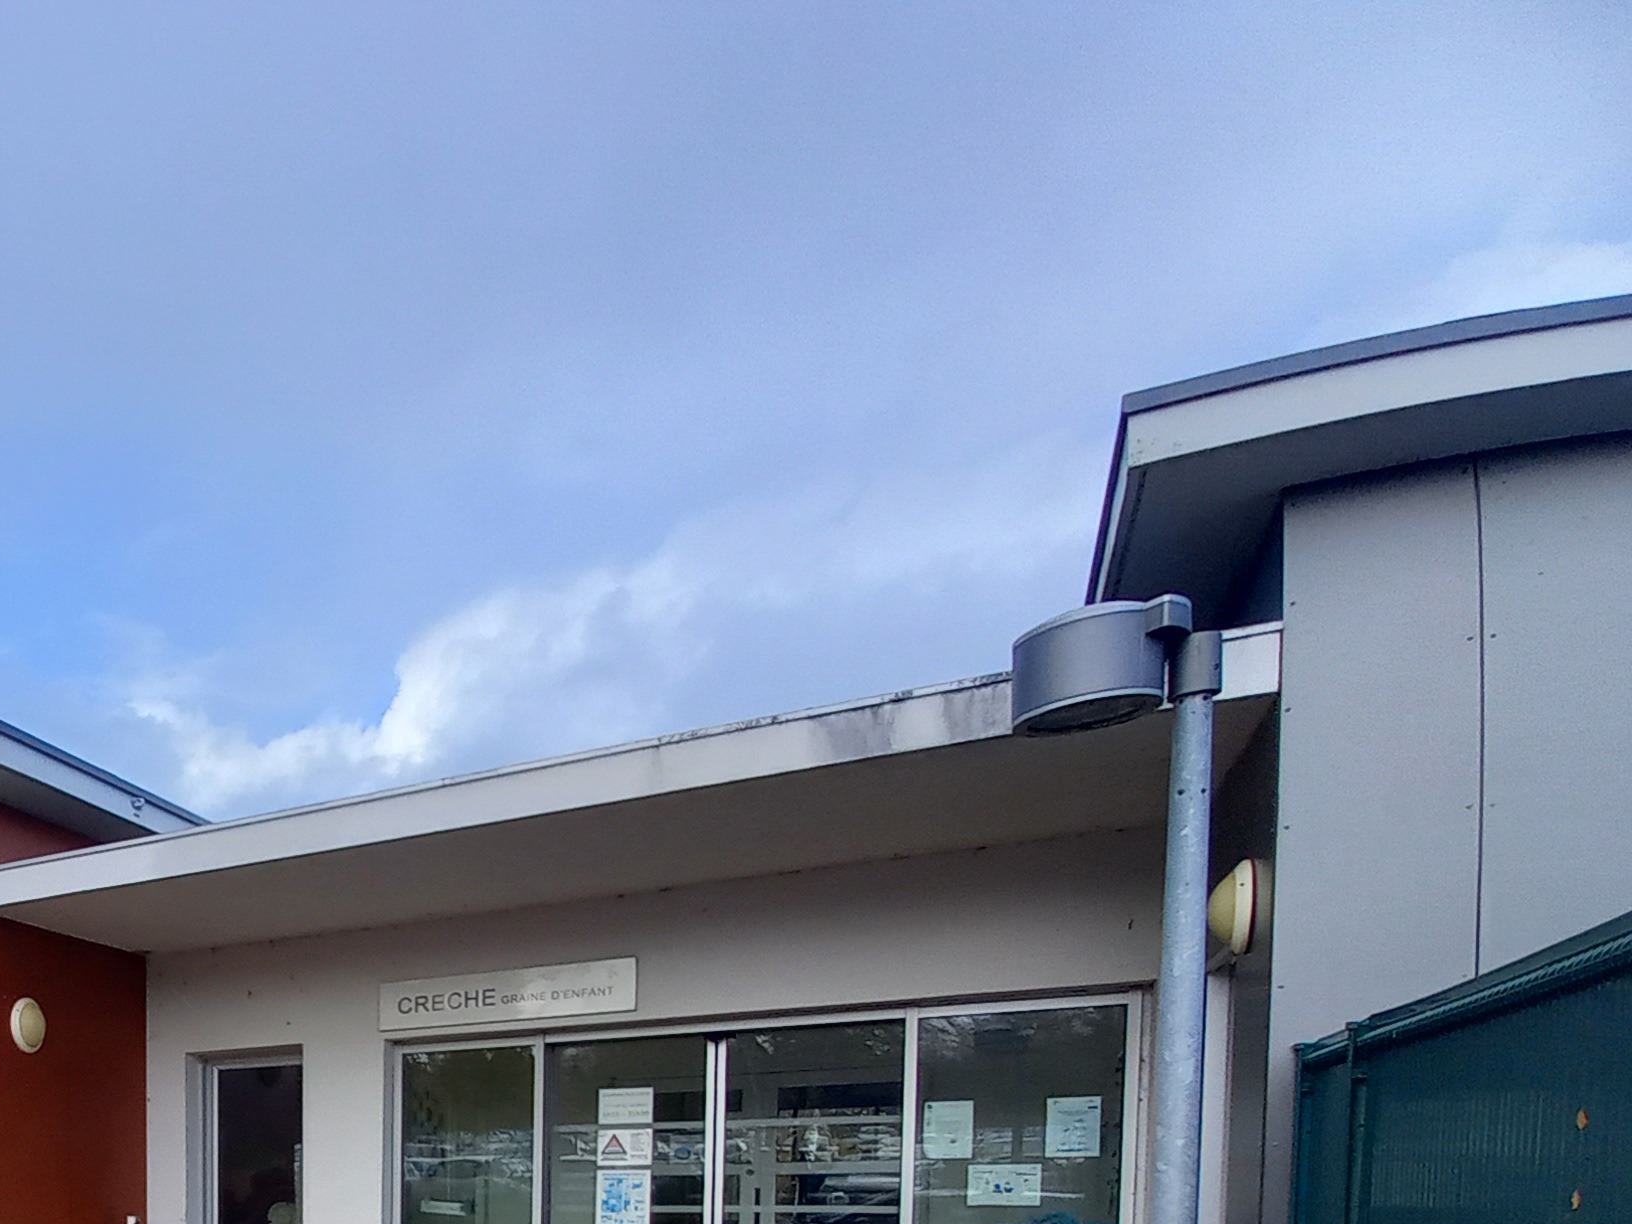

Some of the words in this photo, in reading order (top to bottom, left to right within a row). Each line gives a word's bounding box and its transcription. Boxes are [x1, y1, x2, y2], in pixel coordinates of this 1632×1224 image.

[397, 988, 497, 1015] CRECHE
[500, 991, 547, 1005] GRAINE
[550, 985, 614, 1001] D'ENFANT
